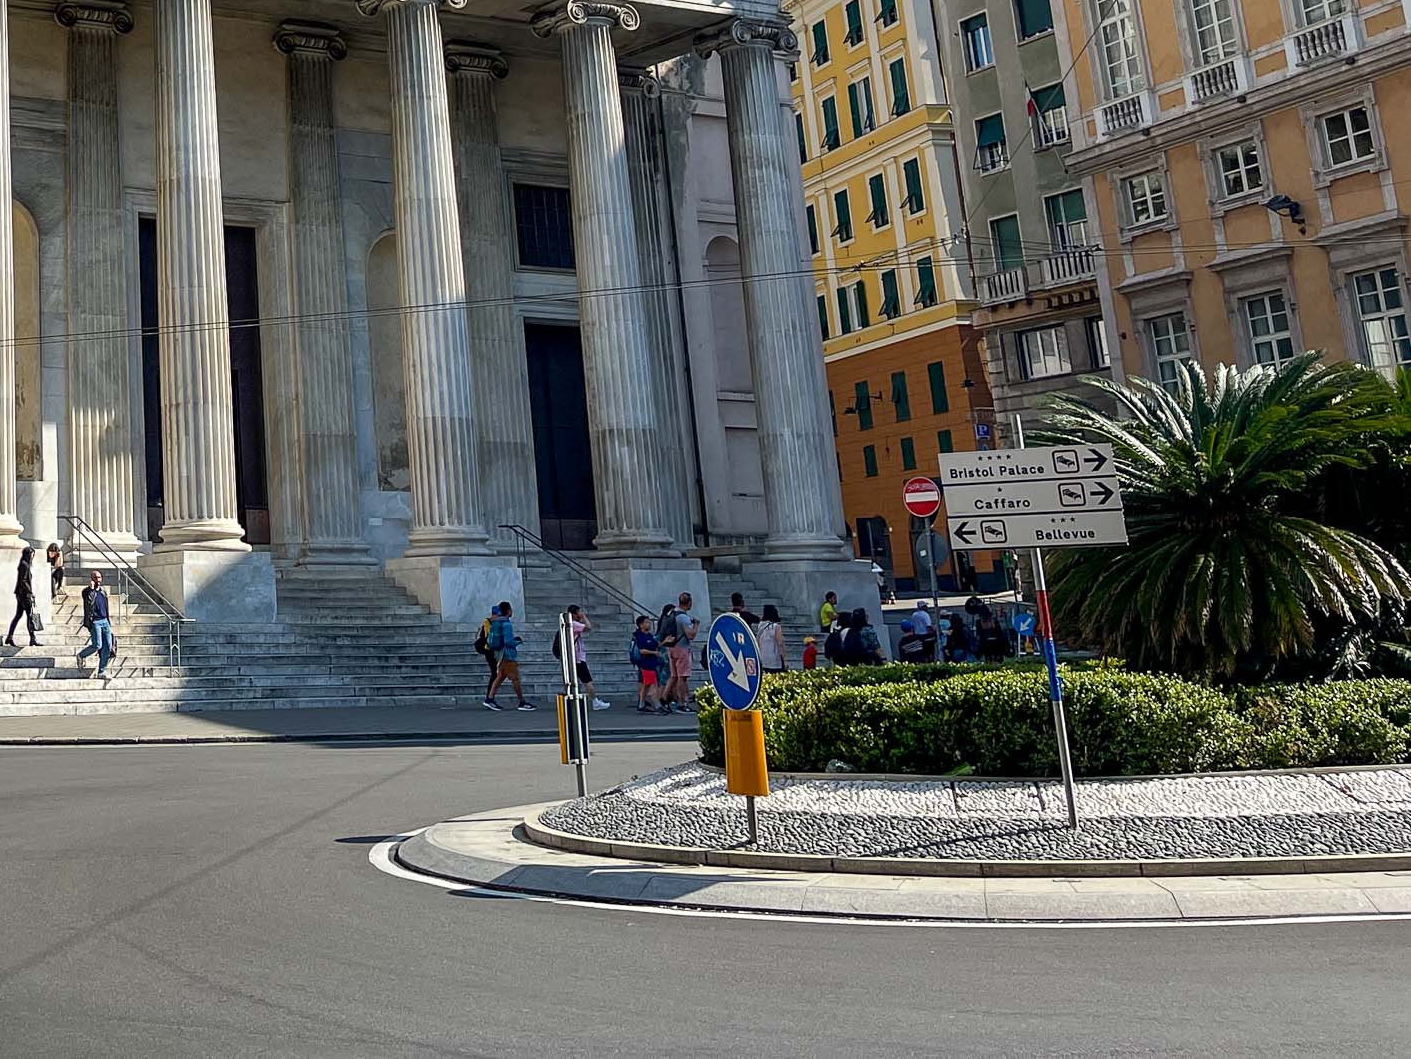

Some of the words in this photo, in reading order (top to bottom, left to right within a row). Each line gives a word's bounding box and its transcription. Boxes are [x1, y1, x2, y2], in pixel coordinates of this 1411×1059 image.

[950, 466, 994, 478] Bristol
[999, 464, 1044, 476] Palace
[974, 498, 1031, 509] Caffaro
[1035, 529, 1095, 540] Bellevue
